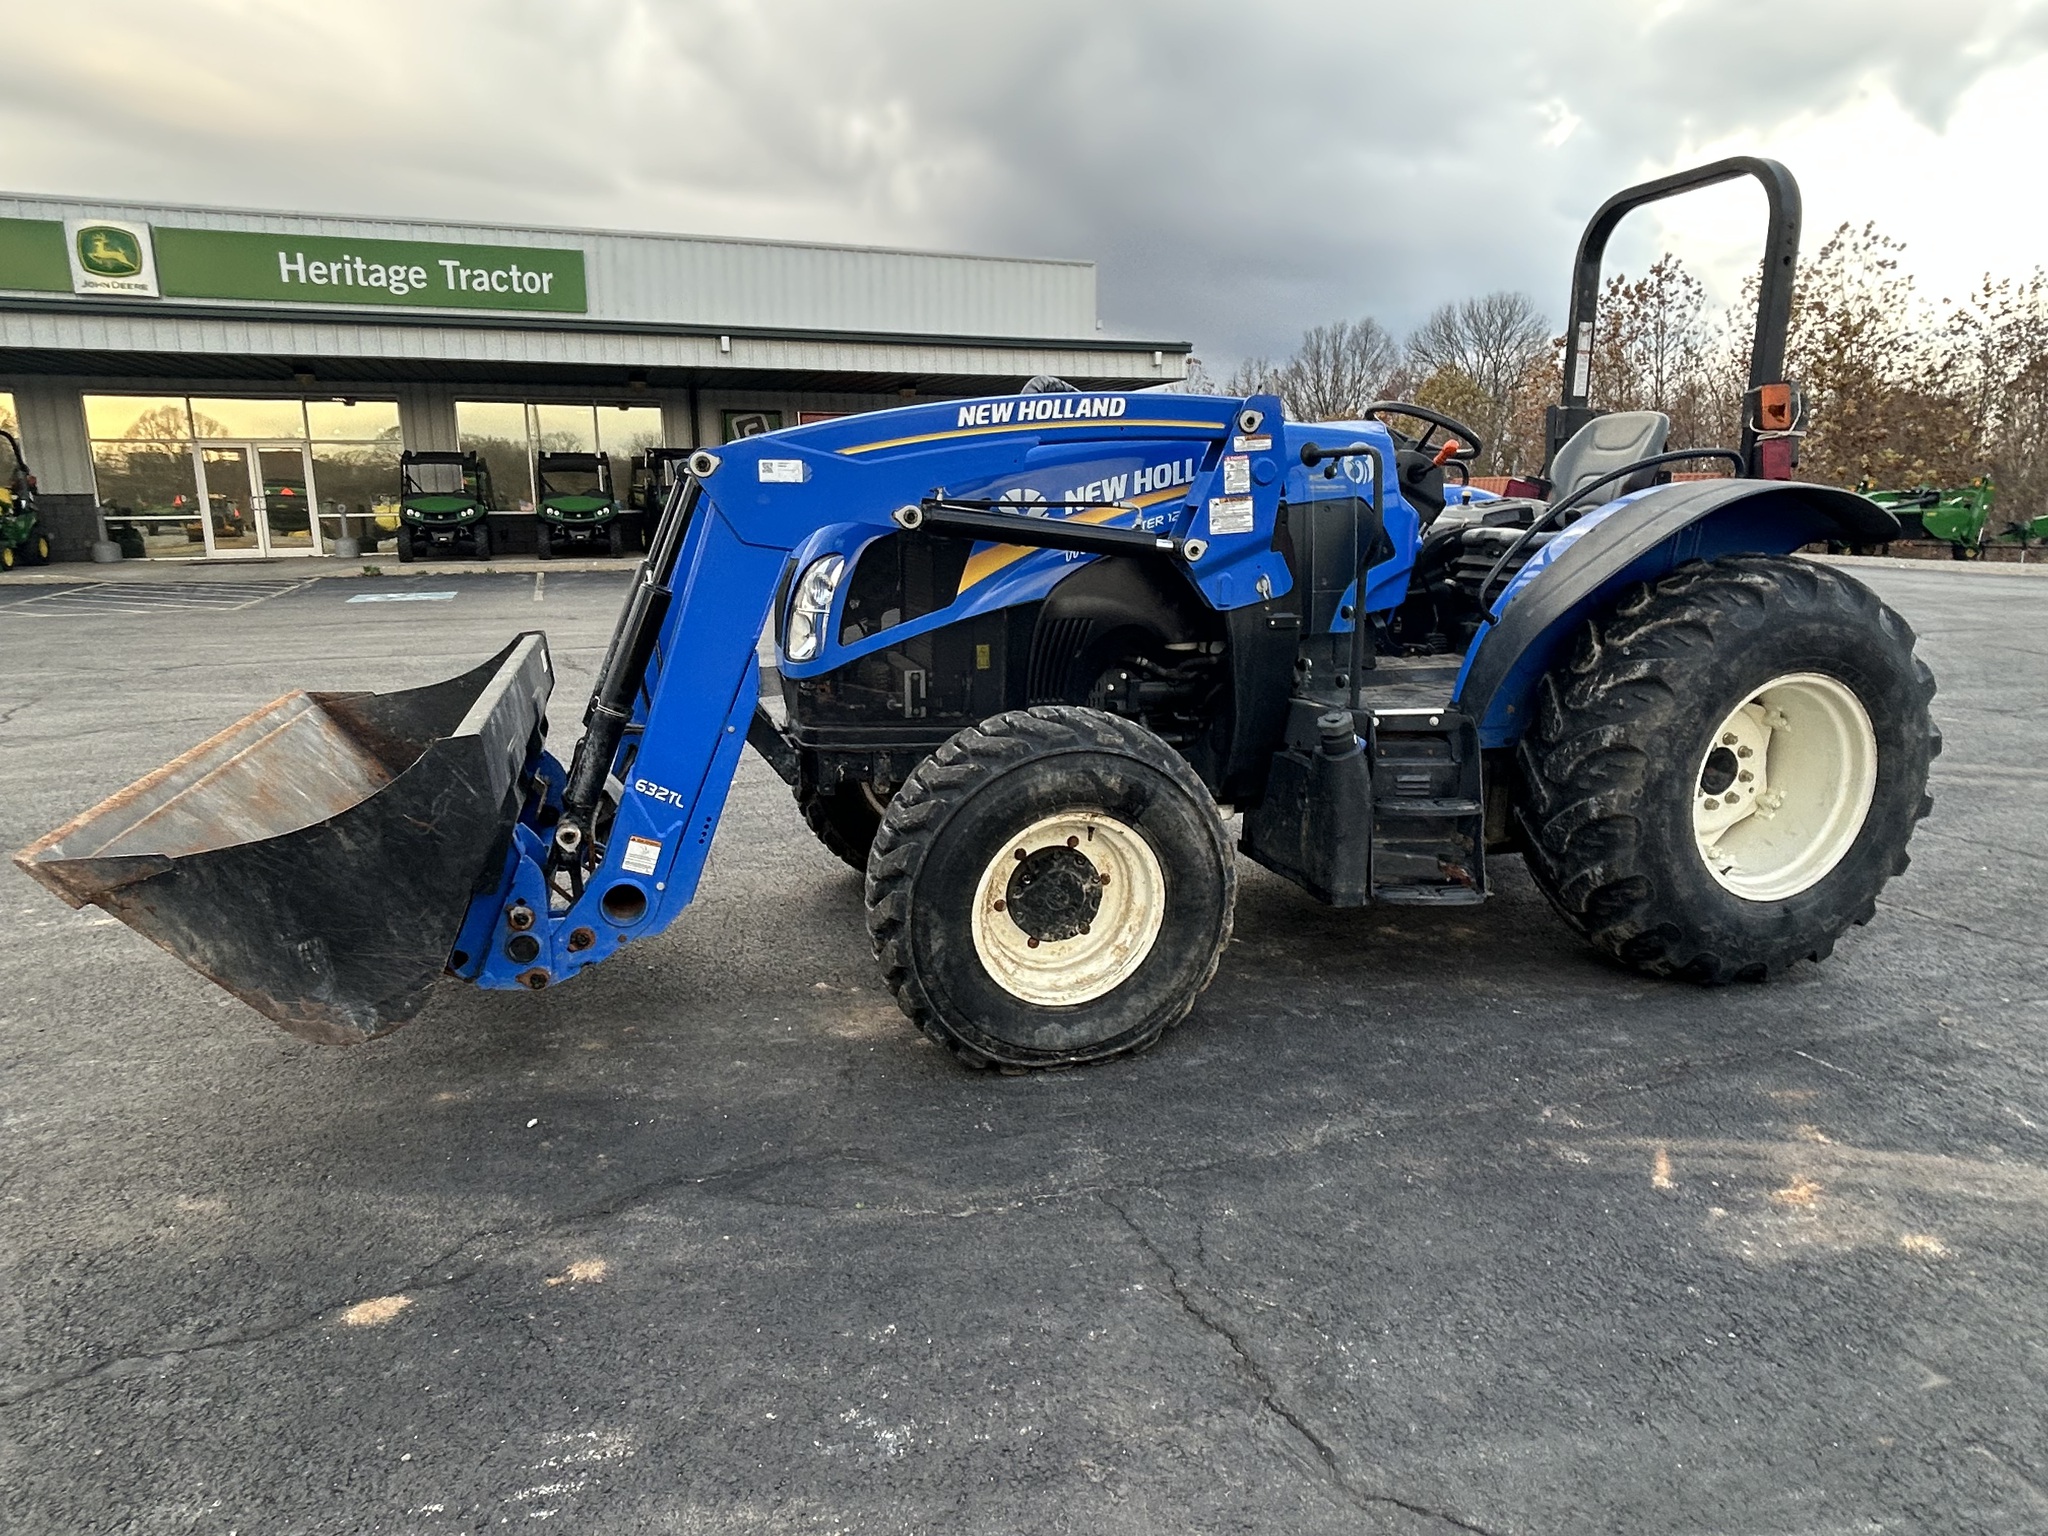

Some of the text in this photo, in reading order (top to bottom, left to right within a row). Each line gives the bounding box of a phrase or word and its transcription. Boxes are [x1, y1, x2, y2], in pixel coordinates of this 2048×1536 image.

[81, 280, 148, 291] JOHN DEERE
[278, 251, 553, 295] Heritage Tractor
[957, 397, 1126, 427] NEW HOLLAND
[1064, 473, 1128, 515] NEW
[634, 779, 684, 809] 632TL
